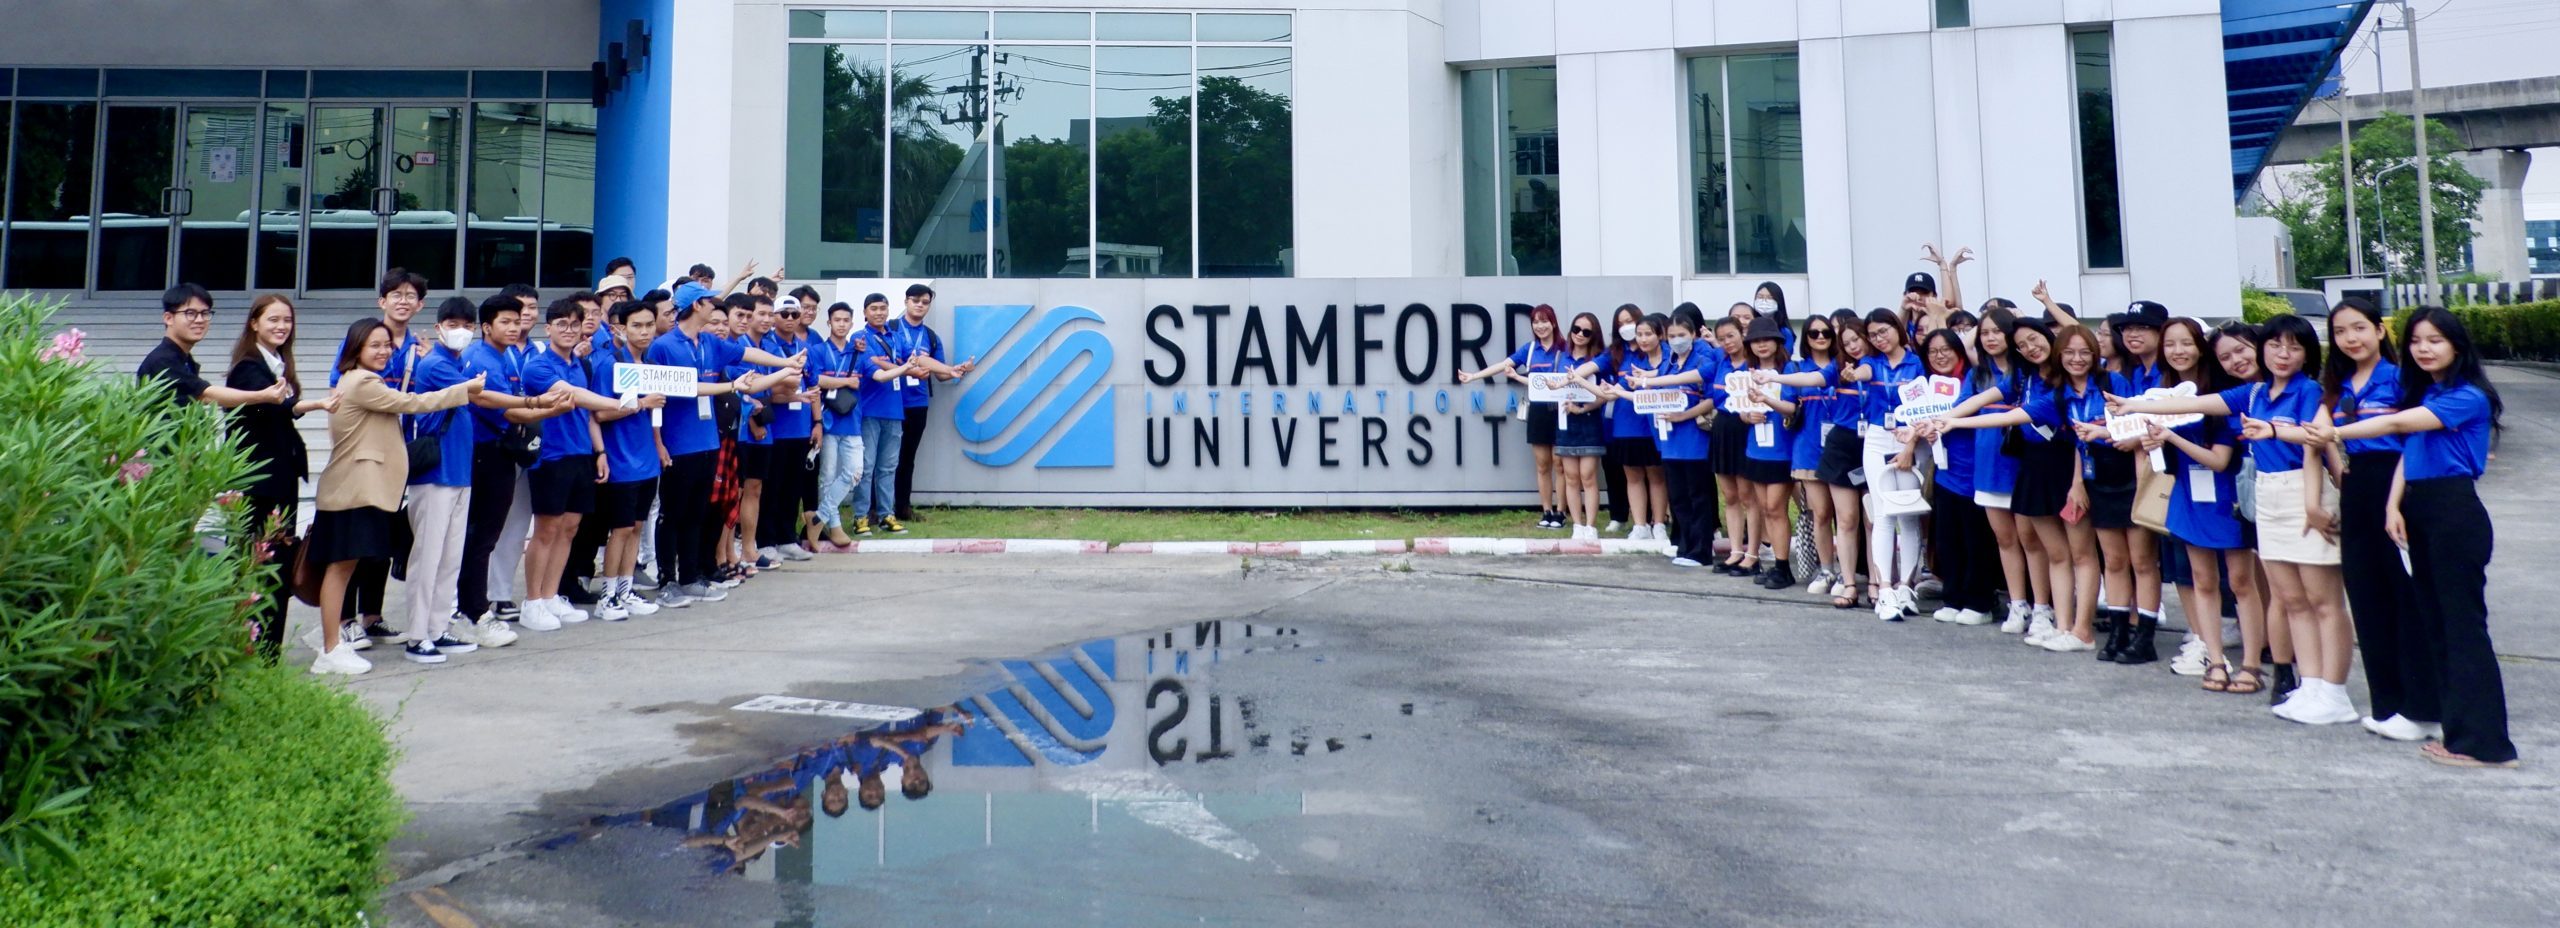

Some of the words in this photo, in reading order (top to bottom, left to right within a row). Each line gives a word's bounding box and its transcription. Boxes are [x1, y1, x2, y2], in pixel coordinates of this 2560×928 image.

[643, 368, 692, 383] STAMFORD
[642, 383, 692, 393] UNIVERSITY
[1145, 389, 1518, 415] INTERNATIONA
[1636, 392, 1657, 404] FIELD
[1660, 391, 1680, 402] TRIP
[1900, 402, 1952, 417] #GREENWI
[1146, 415, 1507, 467] UNIVERSIT
